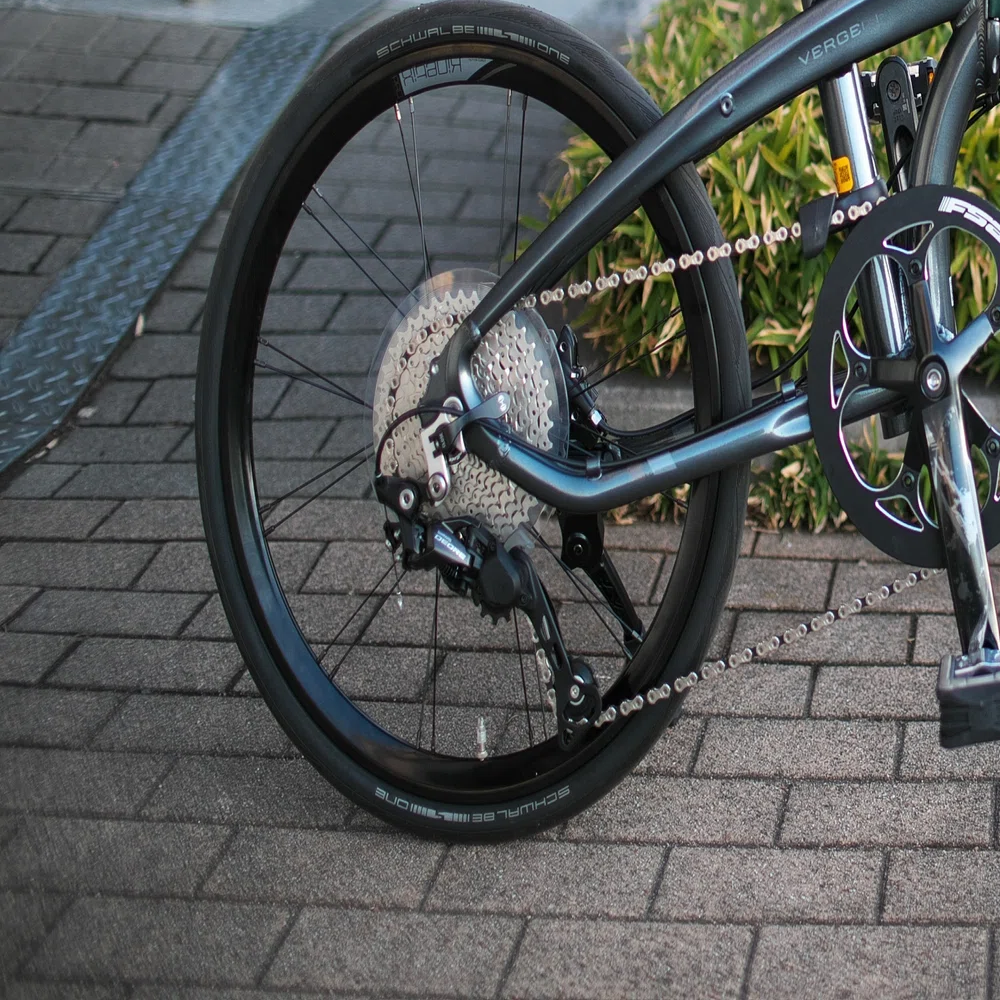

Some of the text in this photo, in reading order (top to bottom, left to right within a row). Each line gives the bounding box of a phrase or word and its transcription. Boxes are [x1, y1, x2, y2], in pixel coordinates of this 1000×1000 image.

[376, 25, 571, 65] SCHWALBE ONE
[798, 23, 861, 65] VERGE
[375, 785, 571, 823] SCHWALBE ONE
